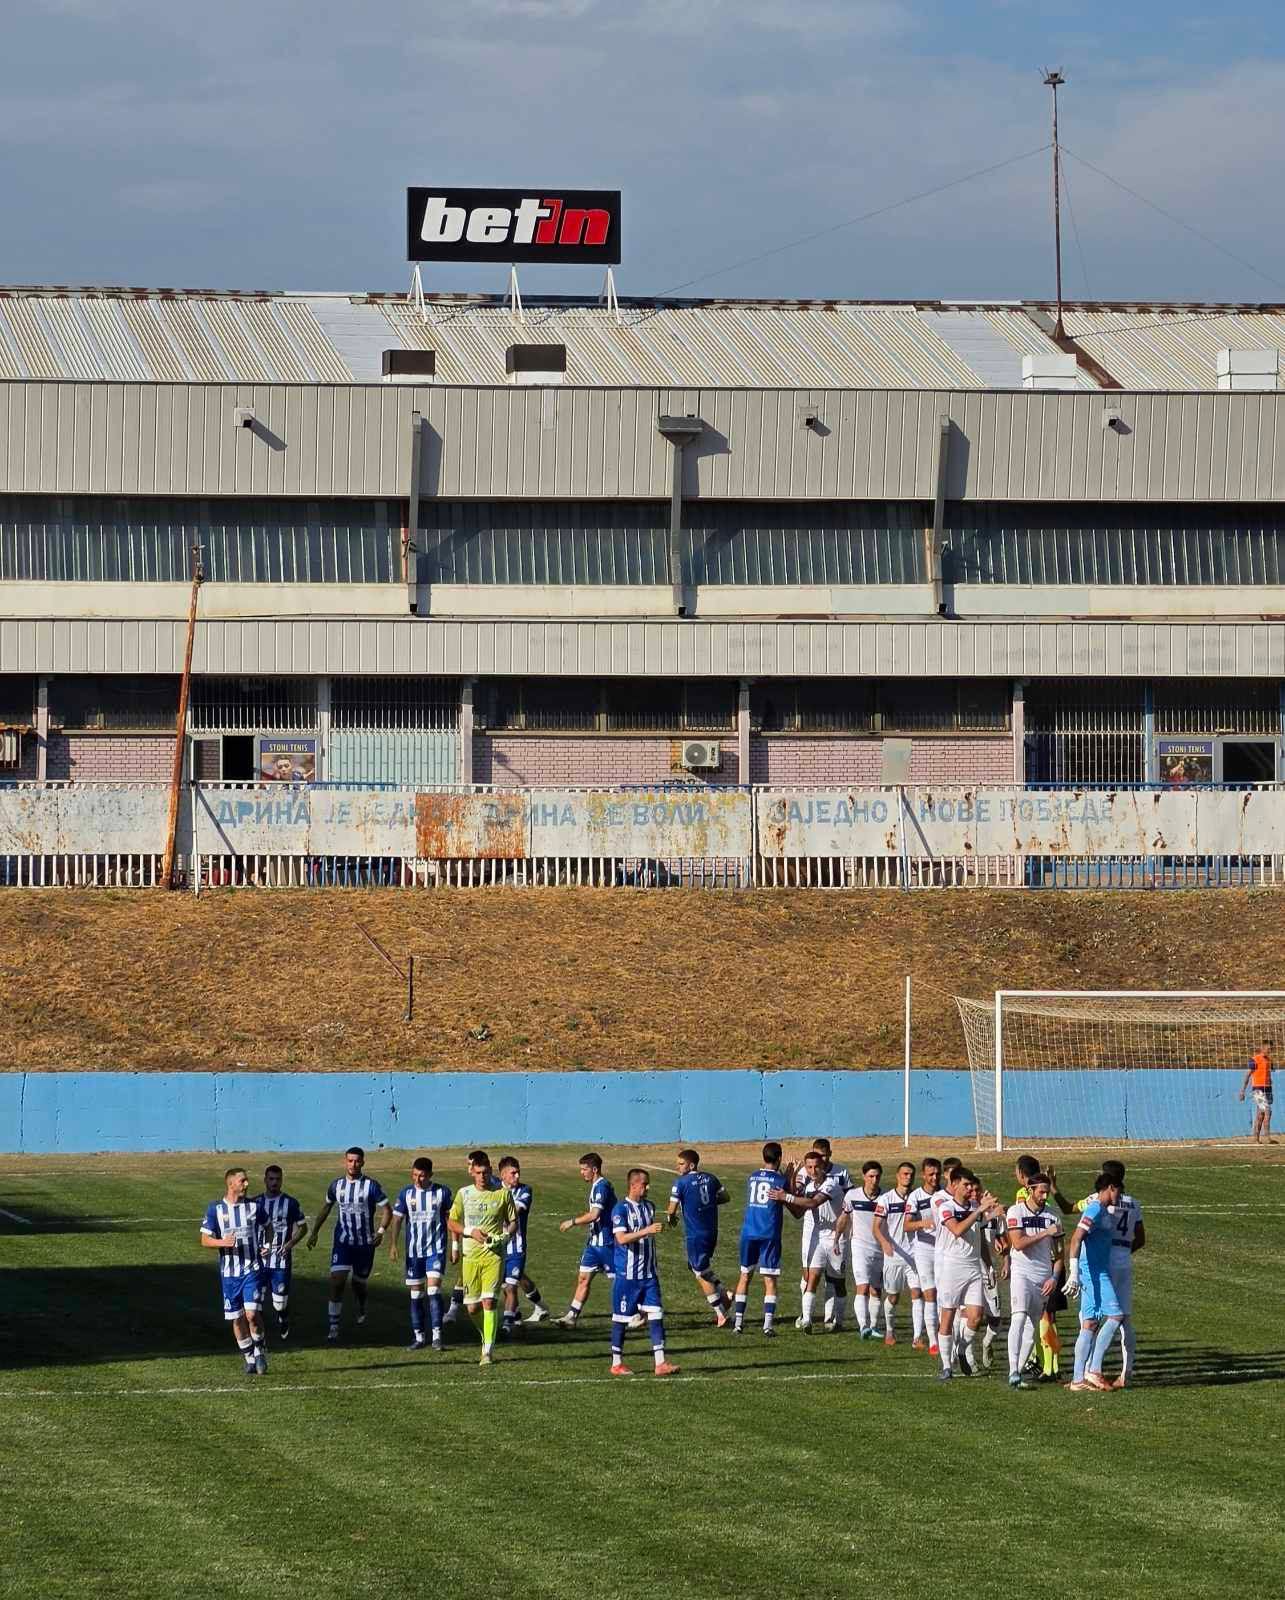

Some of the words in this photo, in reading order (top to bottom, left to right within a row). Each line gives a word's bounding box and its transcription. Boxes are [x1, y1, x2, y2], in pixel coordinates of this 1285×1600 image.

[420, 197, 611, 245] betin
[268, 743, 288, 752] STONI
[290, 743, 308, 752] TENIS
[1167, 745, 1187, 753] STONI
[1188, 745, 1205, 753] TENIS
[216, 799, 311, 828] ДРИНА
[768, 798, 889, 827] ЗАЈЕДНО
[919, 799, 991, 823] НОВЕ
[749, 1181, 771, 1204] 18
[1116, 1210, 1129, 1236] 4
